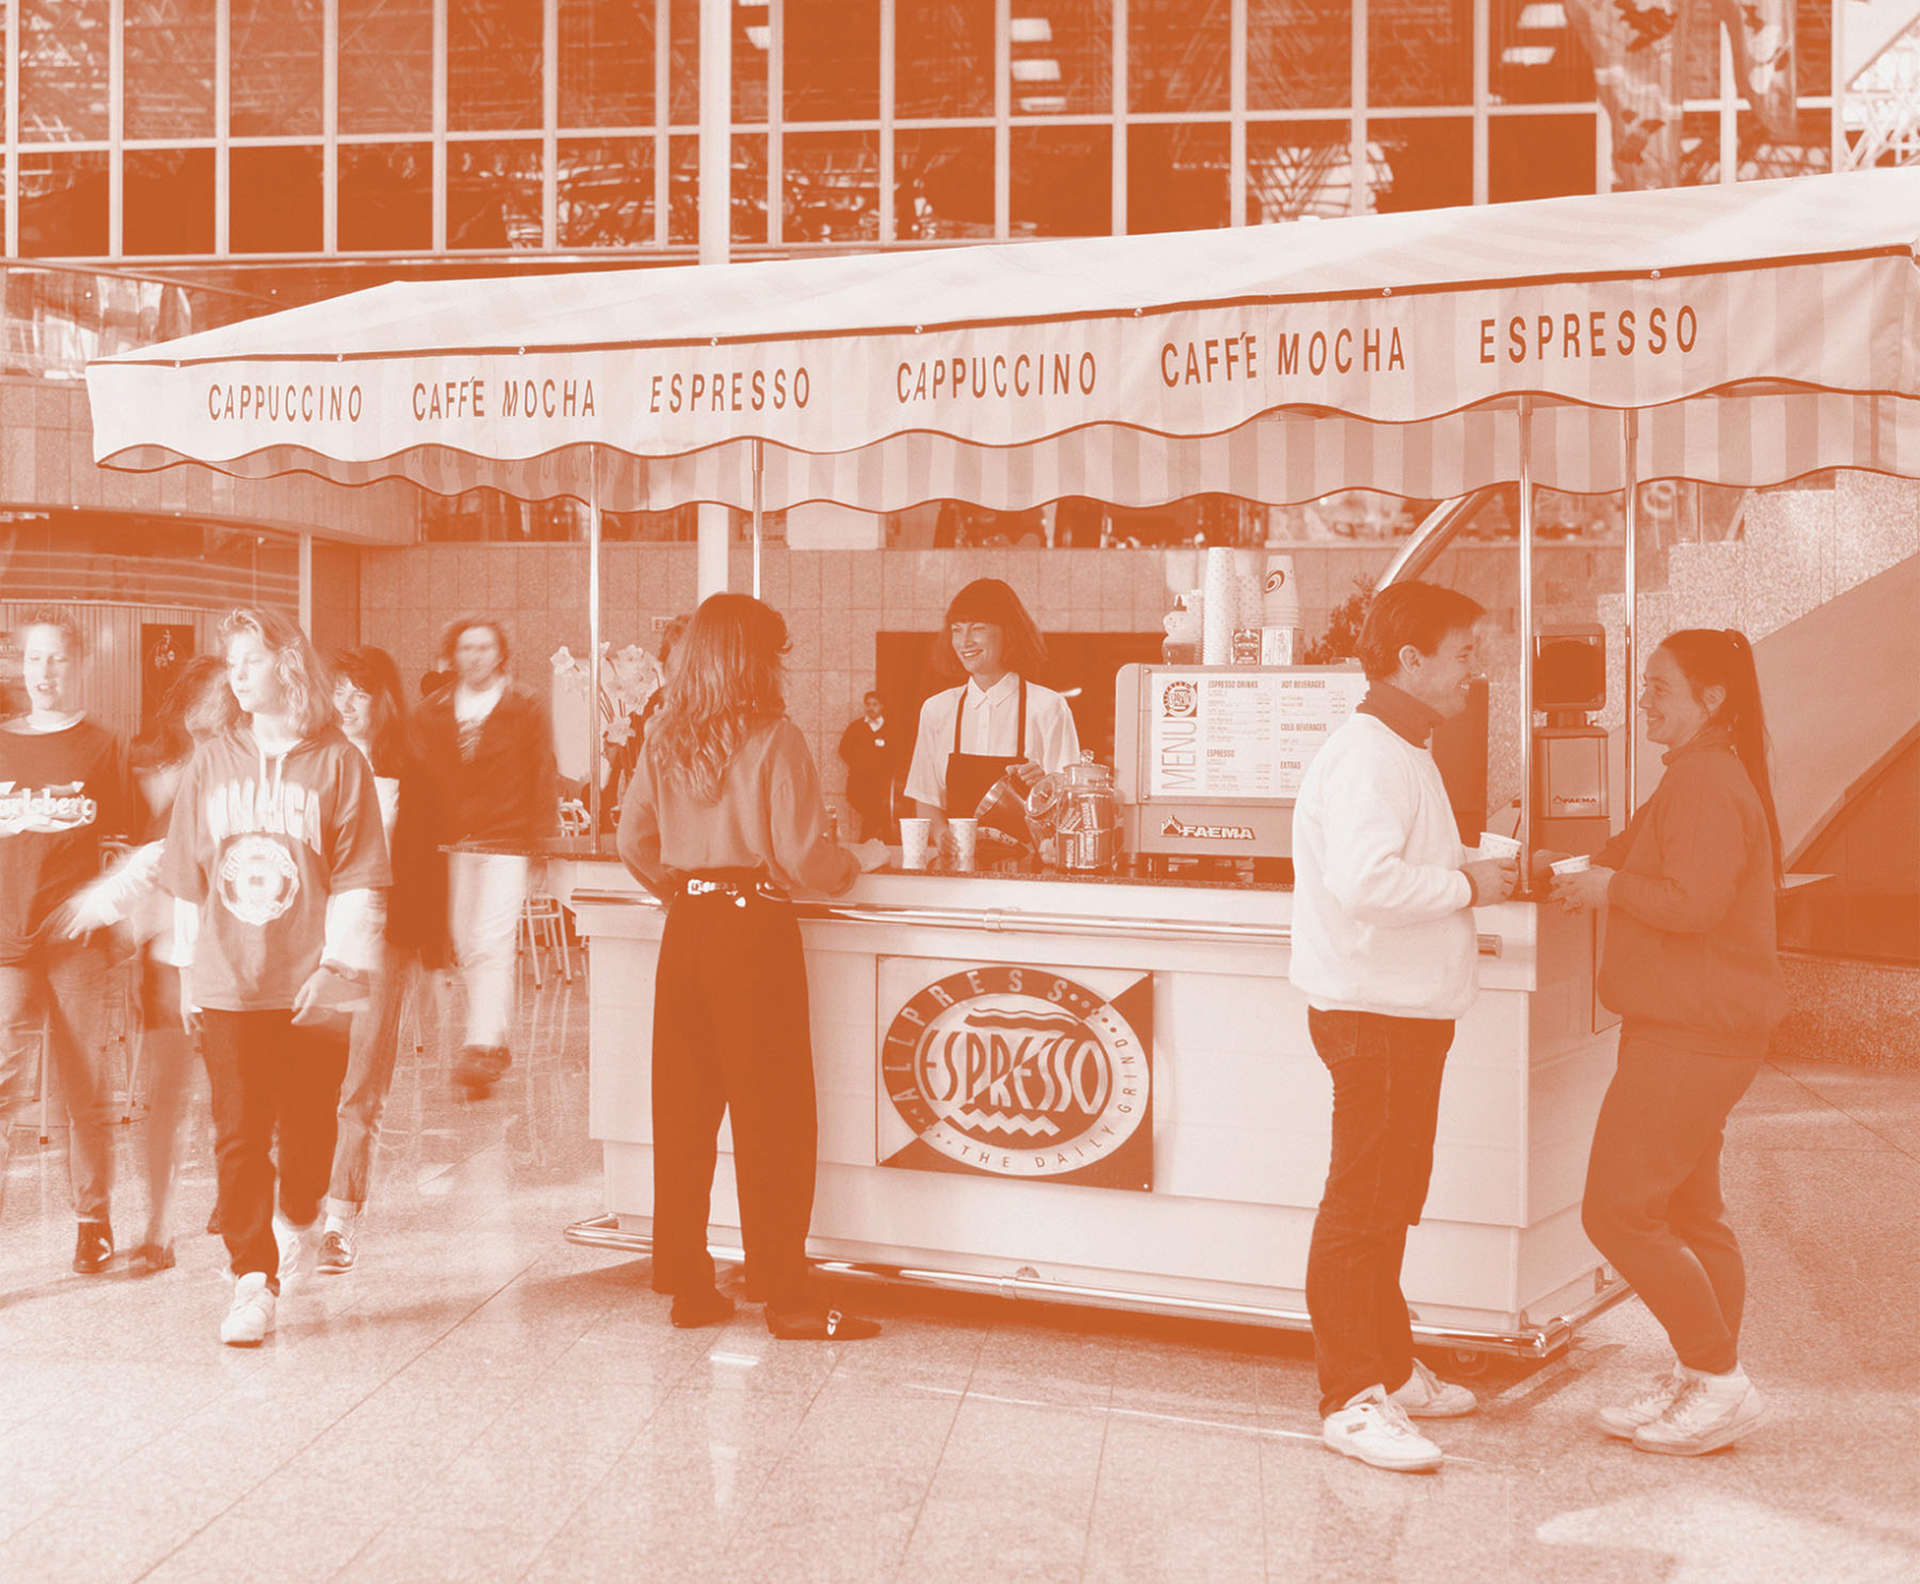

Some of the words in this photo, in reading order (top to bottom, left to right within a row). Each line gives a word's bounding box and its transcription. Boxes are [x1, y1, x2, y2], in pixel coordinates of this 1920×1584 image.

[1278, 327, 1405, 376] MOCHA
[1480, 305, 1697, 363] ESPRESSO
[502, 379, 594, 418] MOCHA
[650, 367, 810, 413] ESPRESSO
[897, 352, 1096, 403] CAPPUCCINO
[209, 384, 361, 422] CAPPUCCINO
[1207, 680, 1235, 689] ESPRESSO
[1161, 720, 1197, 790] MENU
[1181, 825, 1255, 840] FAEMA
[884, 969, 1068, 1102] ALLPRESS
[918, 1029, 1108, 1115] ESPRESSO
[960, 1145, 1011, 1169] THE
[1034, 1124, 1116, 1169] DAILY
[1115, 1038, 1138, 1114] GRIND
